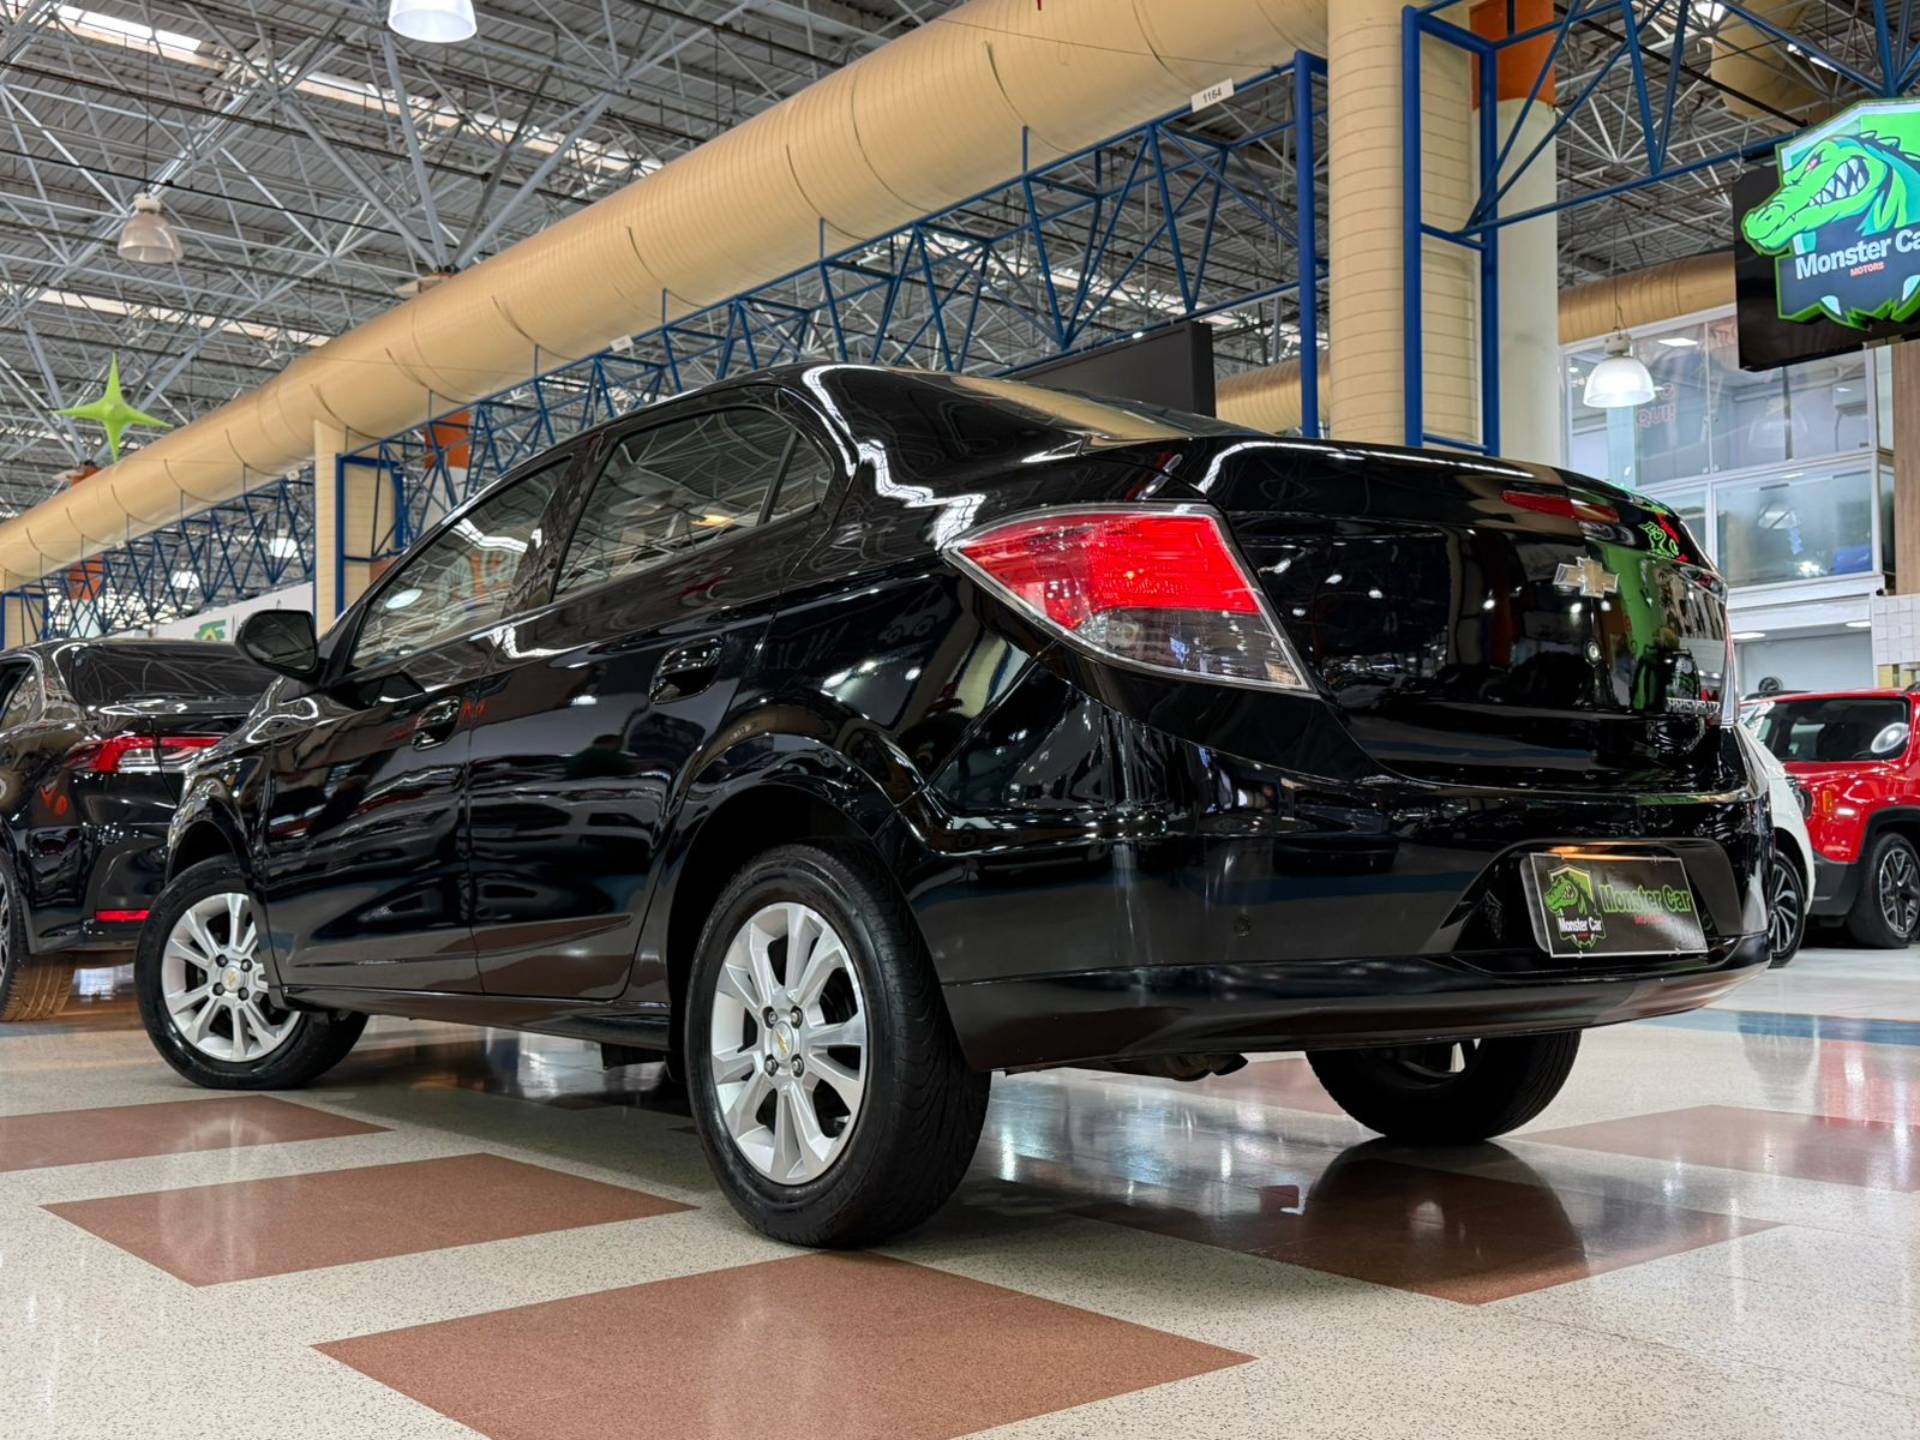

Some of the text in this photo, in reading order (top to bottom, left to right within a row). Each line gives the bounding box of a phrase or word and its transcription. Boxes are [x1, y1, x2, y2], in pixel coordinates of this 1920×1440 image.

[1795, 228, 1920, 280] Monster Ca
[1849, 261, 1885, 277] MOTORS
[1598, 884, 1691, 913] Monster Car
